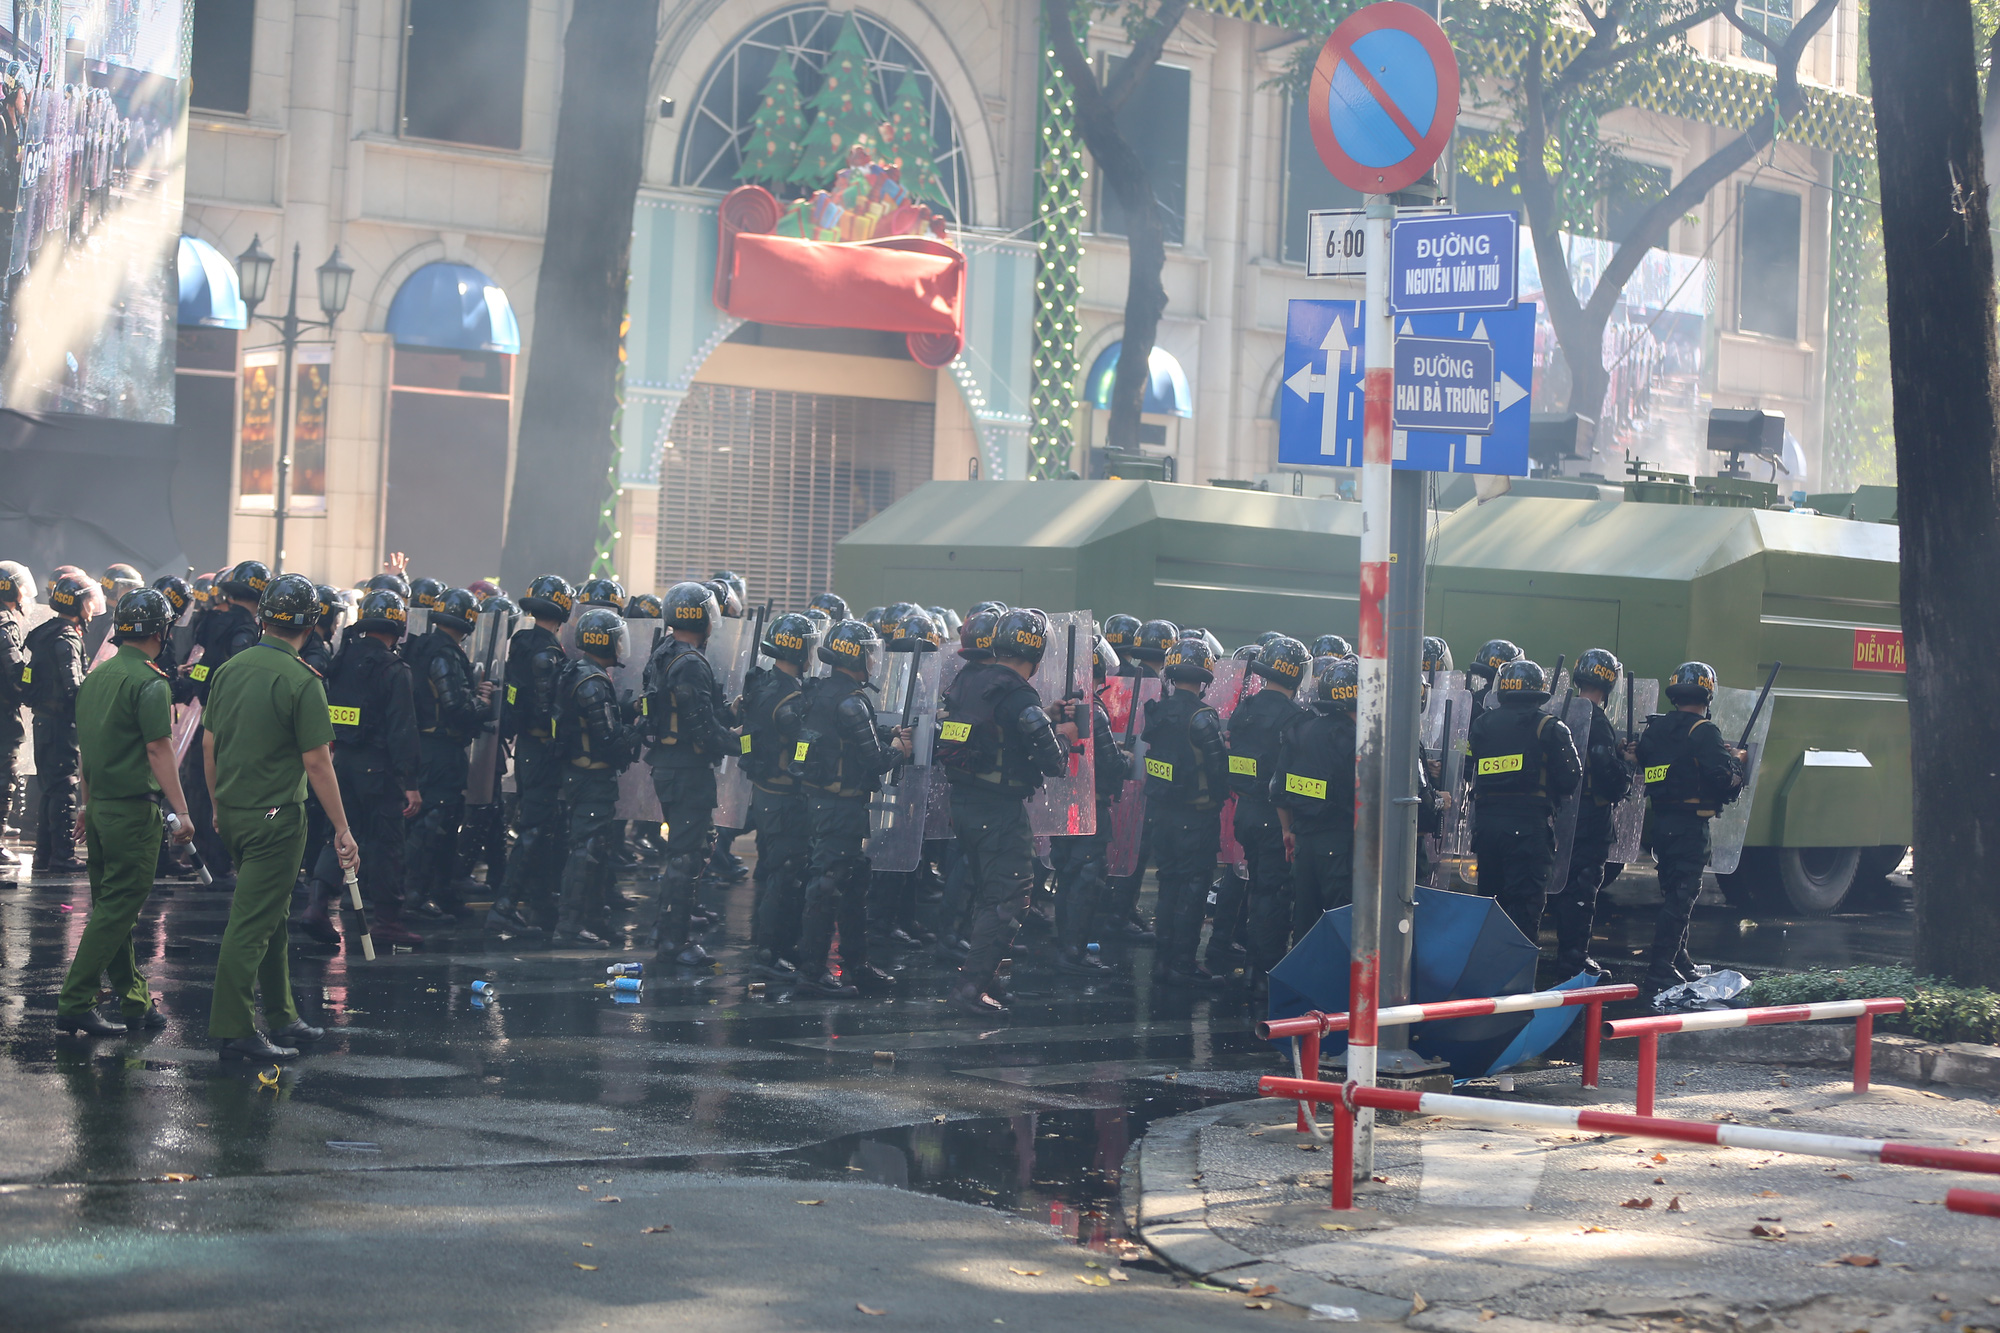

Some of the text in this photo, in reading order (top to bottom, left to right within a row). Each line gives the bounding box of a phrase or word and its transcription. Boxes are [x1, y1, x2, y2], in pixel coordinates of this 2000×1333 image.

[1326, 229, 1364, 258] 6:00
[1417, 232, 1490, 259] ĐƯỜNG
[1405, 255, 1500, 295] NGUYỄN VĂN THỦ
[1413, 353, 1473, 379] ĐƯỜNG
[1396, 381, 1489, 414] HAI BÀ TRƯNG
[1857, 634, 1884, 663] DIỄN
